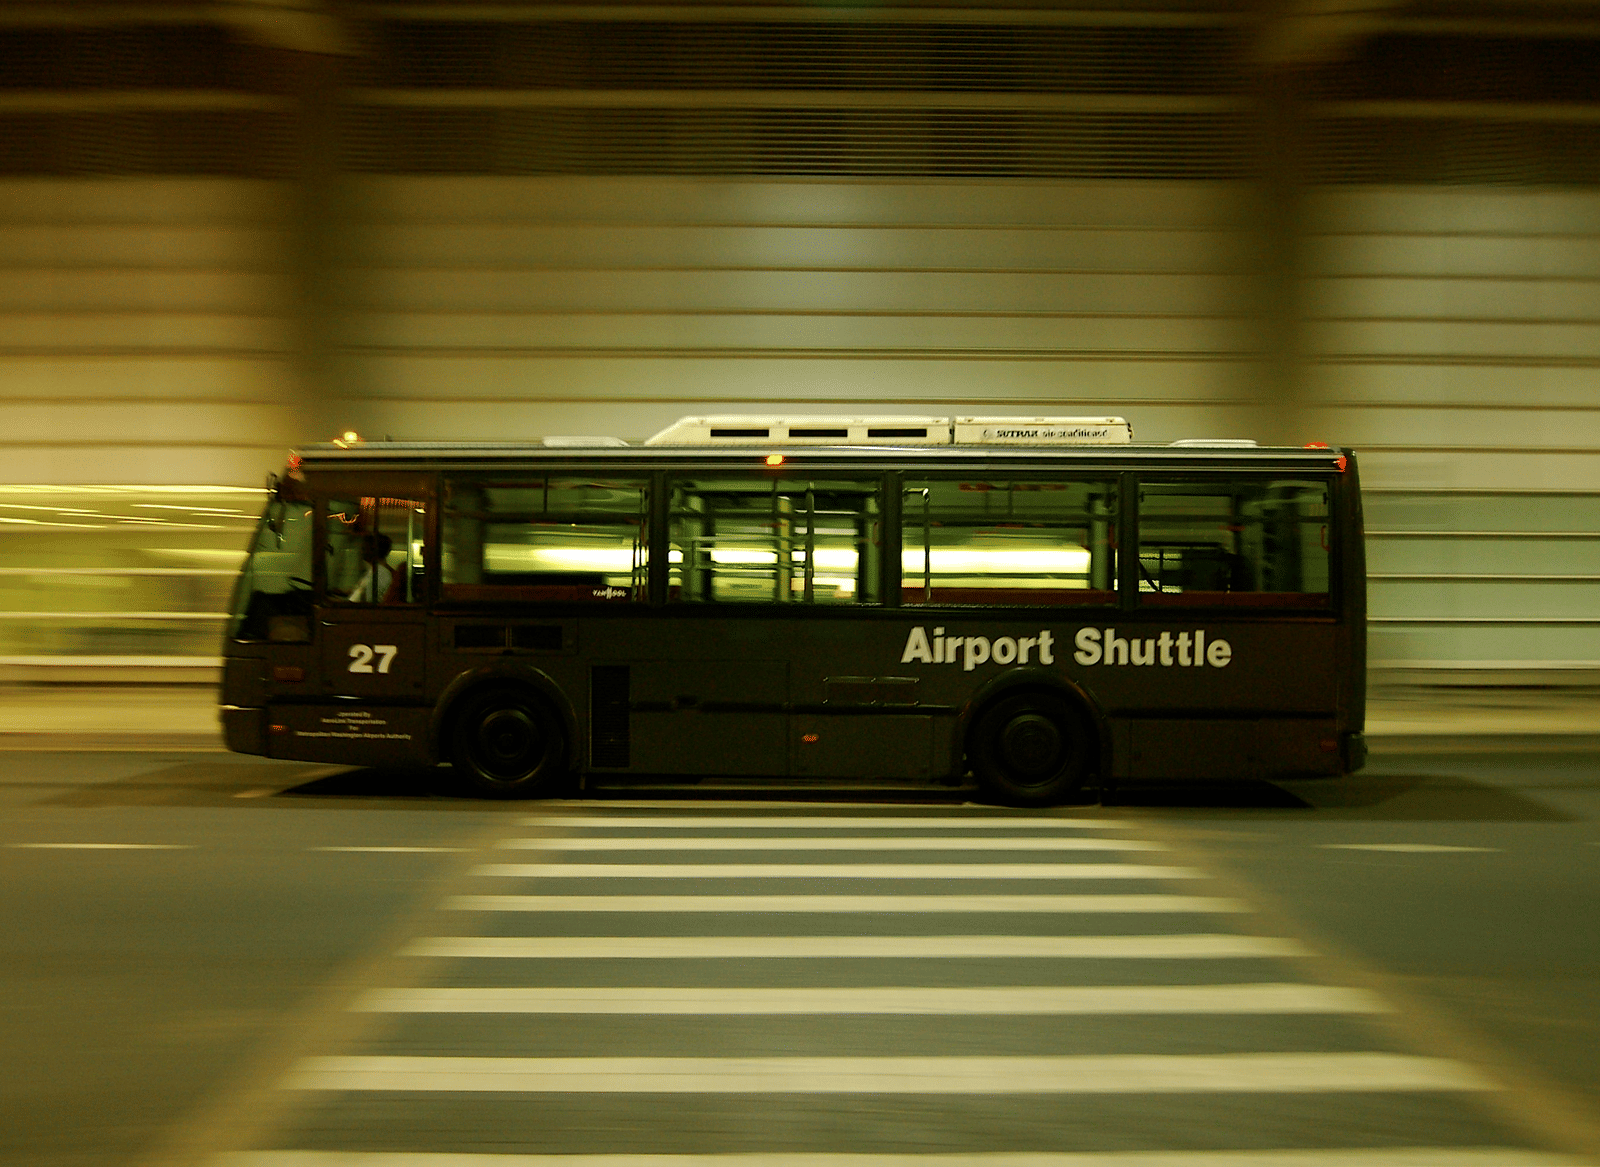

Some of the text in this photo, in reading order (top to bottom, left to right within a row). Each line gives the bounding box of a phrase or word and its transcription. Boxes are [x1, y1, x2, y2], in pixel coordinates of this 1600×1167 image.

[348, 643, 398, 674] 27
[901, 626, 1232, 671] Airport Shuttle
